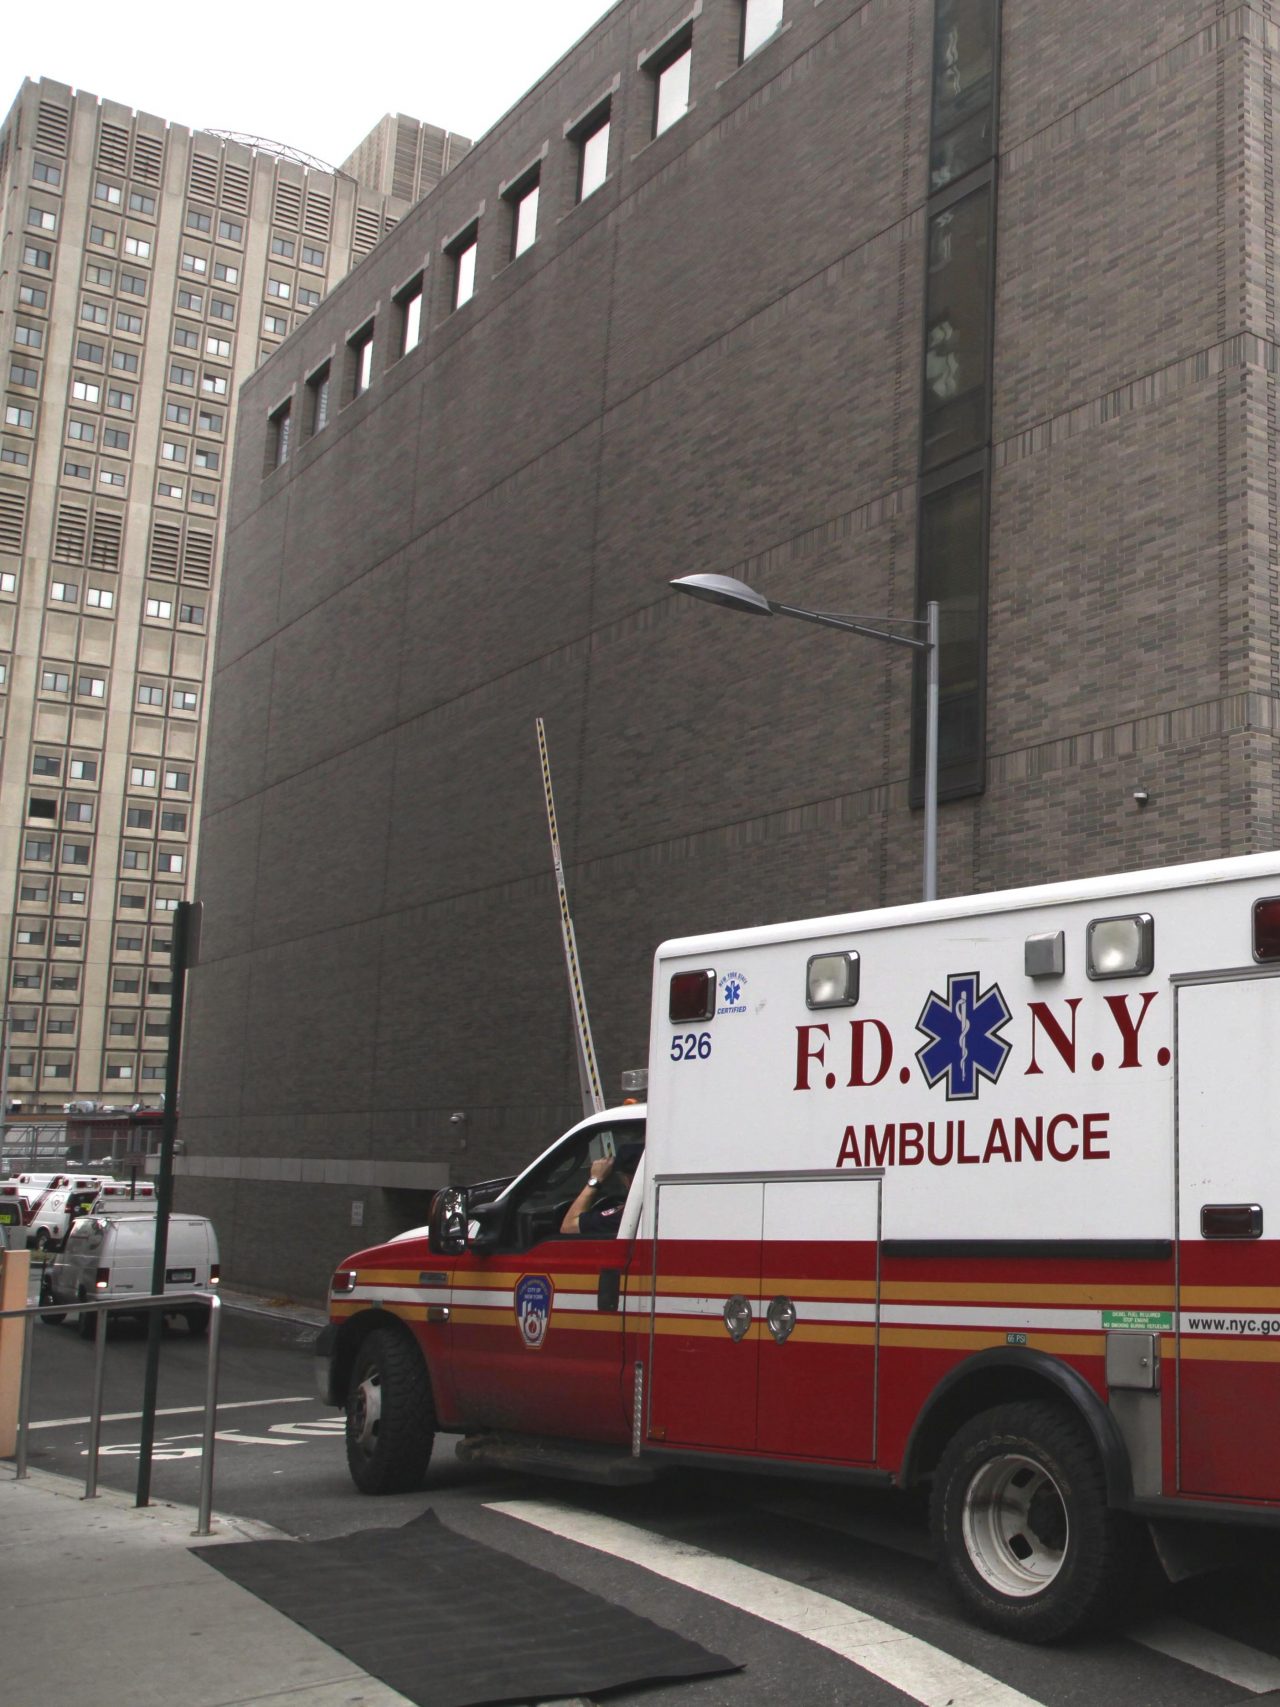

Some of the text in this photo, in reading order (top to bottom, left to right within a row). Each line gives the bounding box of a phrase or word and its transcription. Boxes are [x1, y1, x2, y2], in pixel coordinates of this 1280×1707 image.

[717, 1005, 747, 1015] CERTIFIED
[670, 1032, 712, 1061] 526
[792, 991, 1171, 1091] F.D. N.Y.
[836, 1112, 1110, 1168] AMBULANCE
